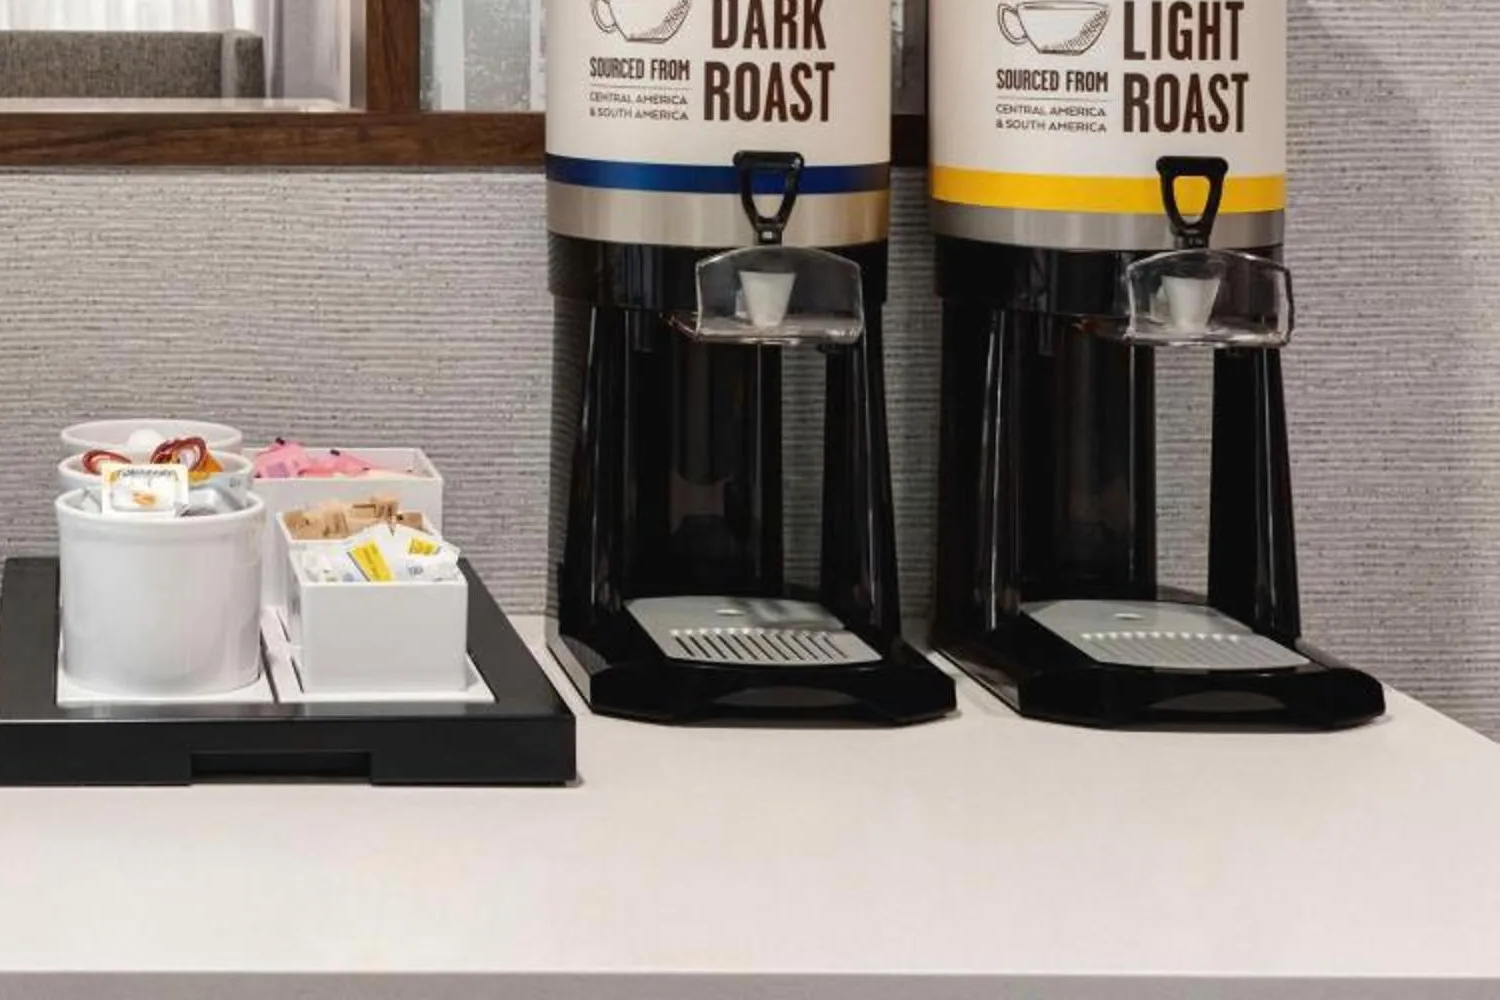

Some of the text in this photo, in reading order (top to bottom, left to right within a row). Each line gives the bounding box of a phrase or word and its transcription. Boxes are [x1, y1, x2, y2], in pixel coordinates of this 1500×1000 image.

[1124, 0, 1244, 60] LIGHT
[590, 57, 690, 81] SOURCED FROM
[996, 69, 1109, 93] SOURCED FROM
[635, 93, 688, 105] AMERICA
[703, 61, 835, 122] ROAST
[1123, 72, 1249, 134] ROAST
[598, 108, 633, 120] SOUTH
[635, 109, 689, 121] AMERICA
[996, 104, 1106, 117] CENTRAL AMERICA
[1005, 119, 1046, 131] SOUTH
[1049, 121, 1106, 133] AMERICA
